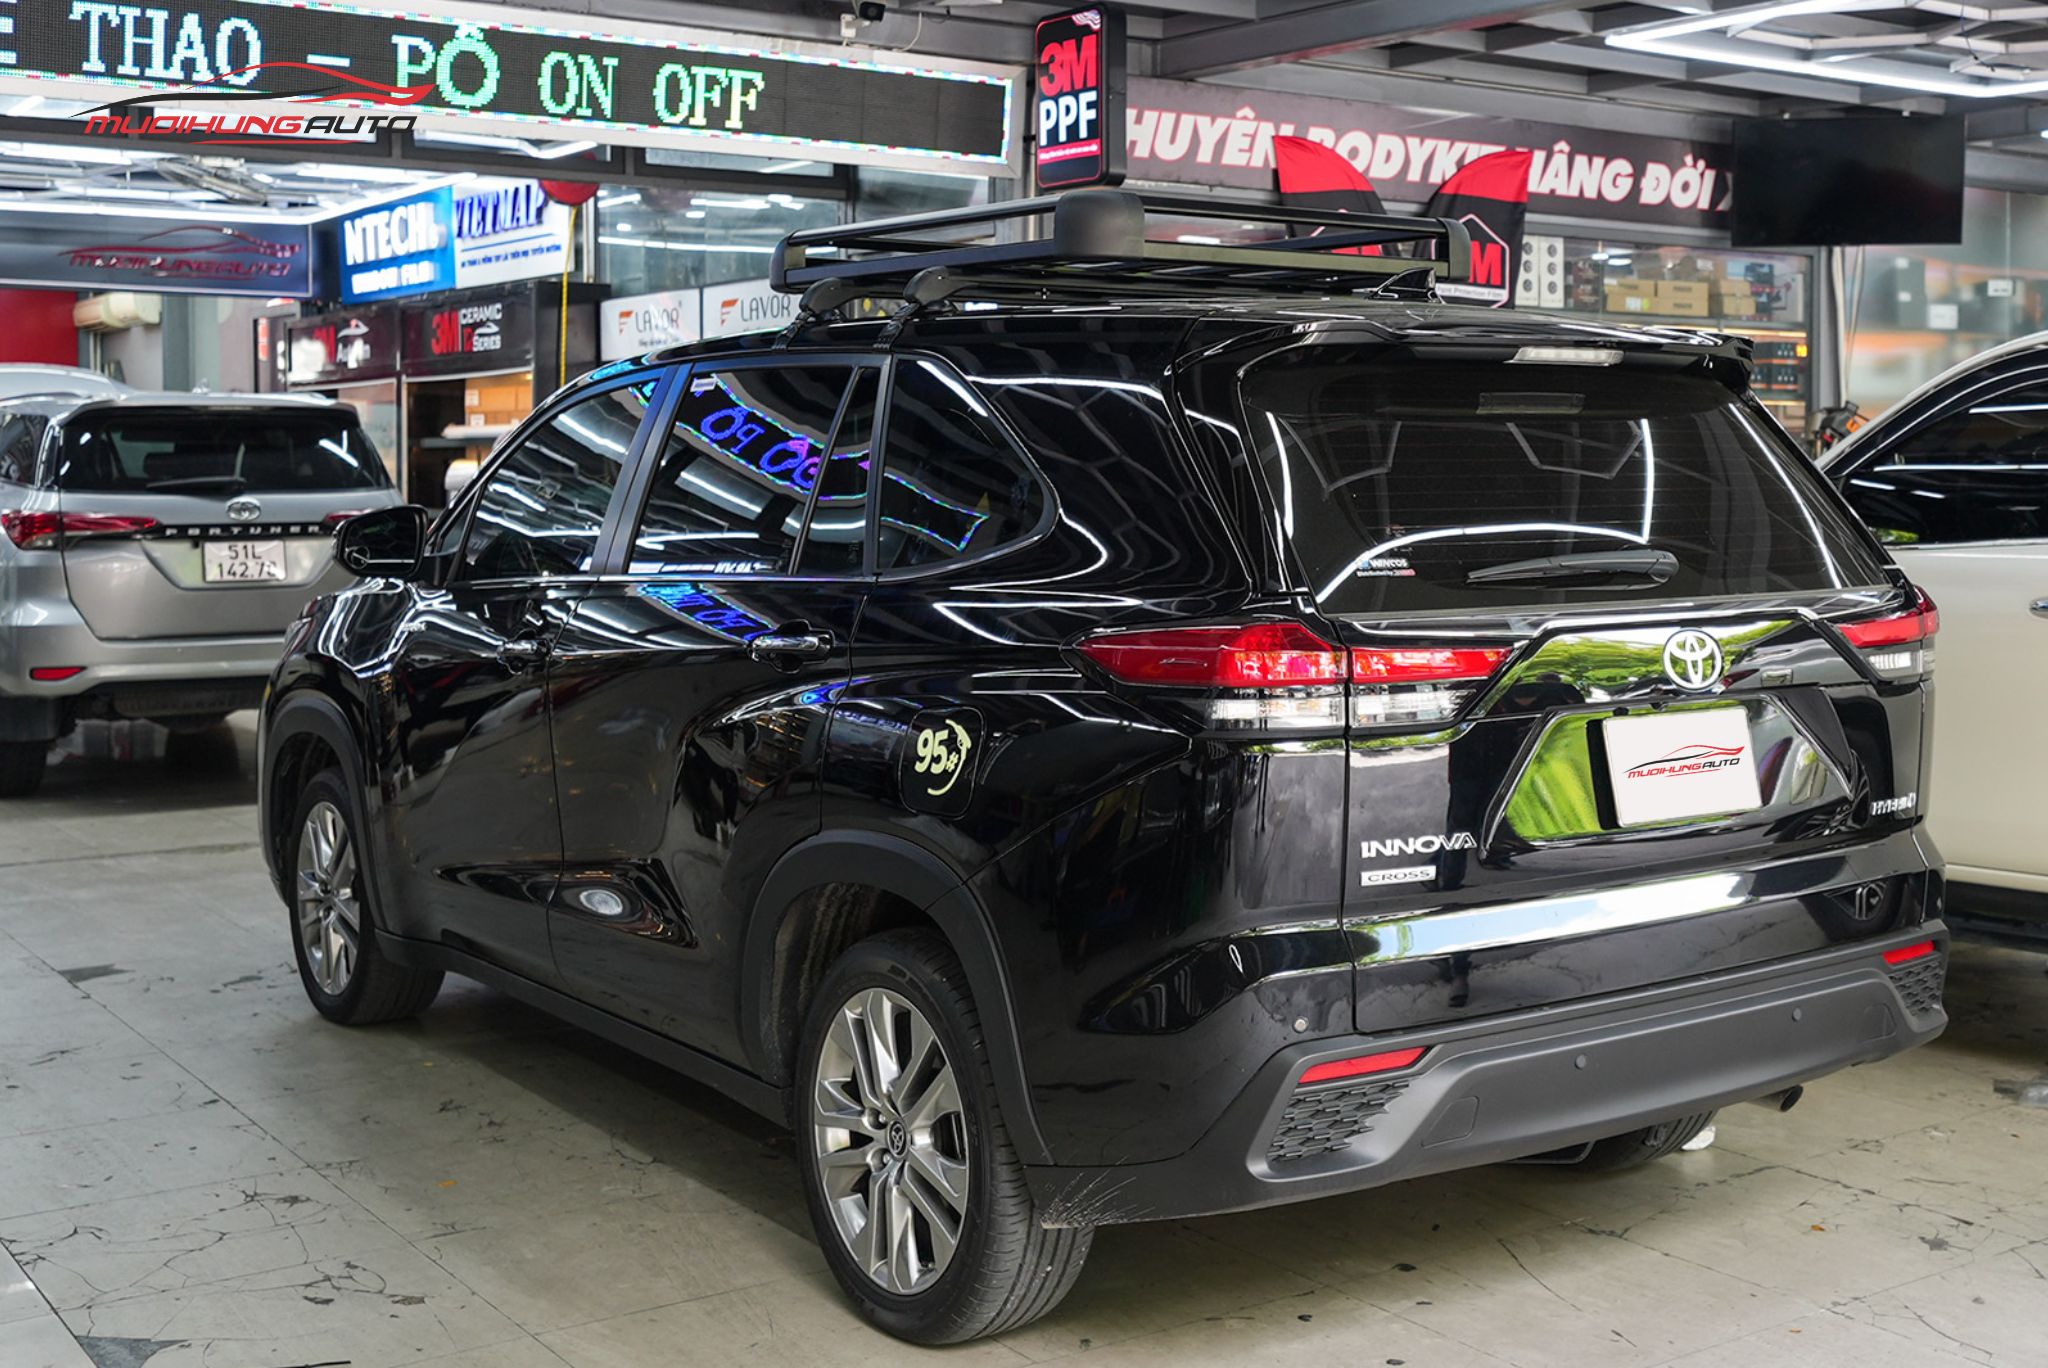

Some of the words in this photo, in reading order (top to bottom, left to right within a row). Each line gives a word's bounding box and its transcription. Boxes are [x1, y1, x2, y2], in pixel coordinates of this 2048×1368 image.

[68, 1, 262, 86] THAO
[538, 51, 619, 119] ON
[653, 63, 766, 129] OFF
[1040, 34, 1097, 97] 3M
[1039, 90, 1097, 146] PPF
[1639, 153, 1716, 211] ĐỜI
[1469, 240, 1502, 286] M
[460, 302, 503, 325] CERAMIC
[635, 308, 680, 333] LAVOR
[741, 296, 791, 322] LAVOR
[432, 309, 459, 356] 3M
[165, 525, 324, 537] FORTUNER
[228, 543, 262, 560] 51L
[1361, 832, 1477, 858] INNOVA
[1367, 869, 1431, 882] CROSS
